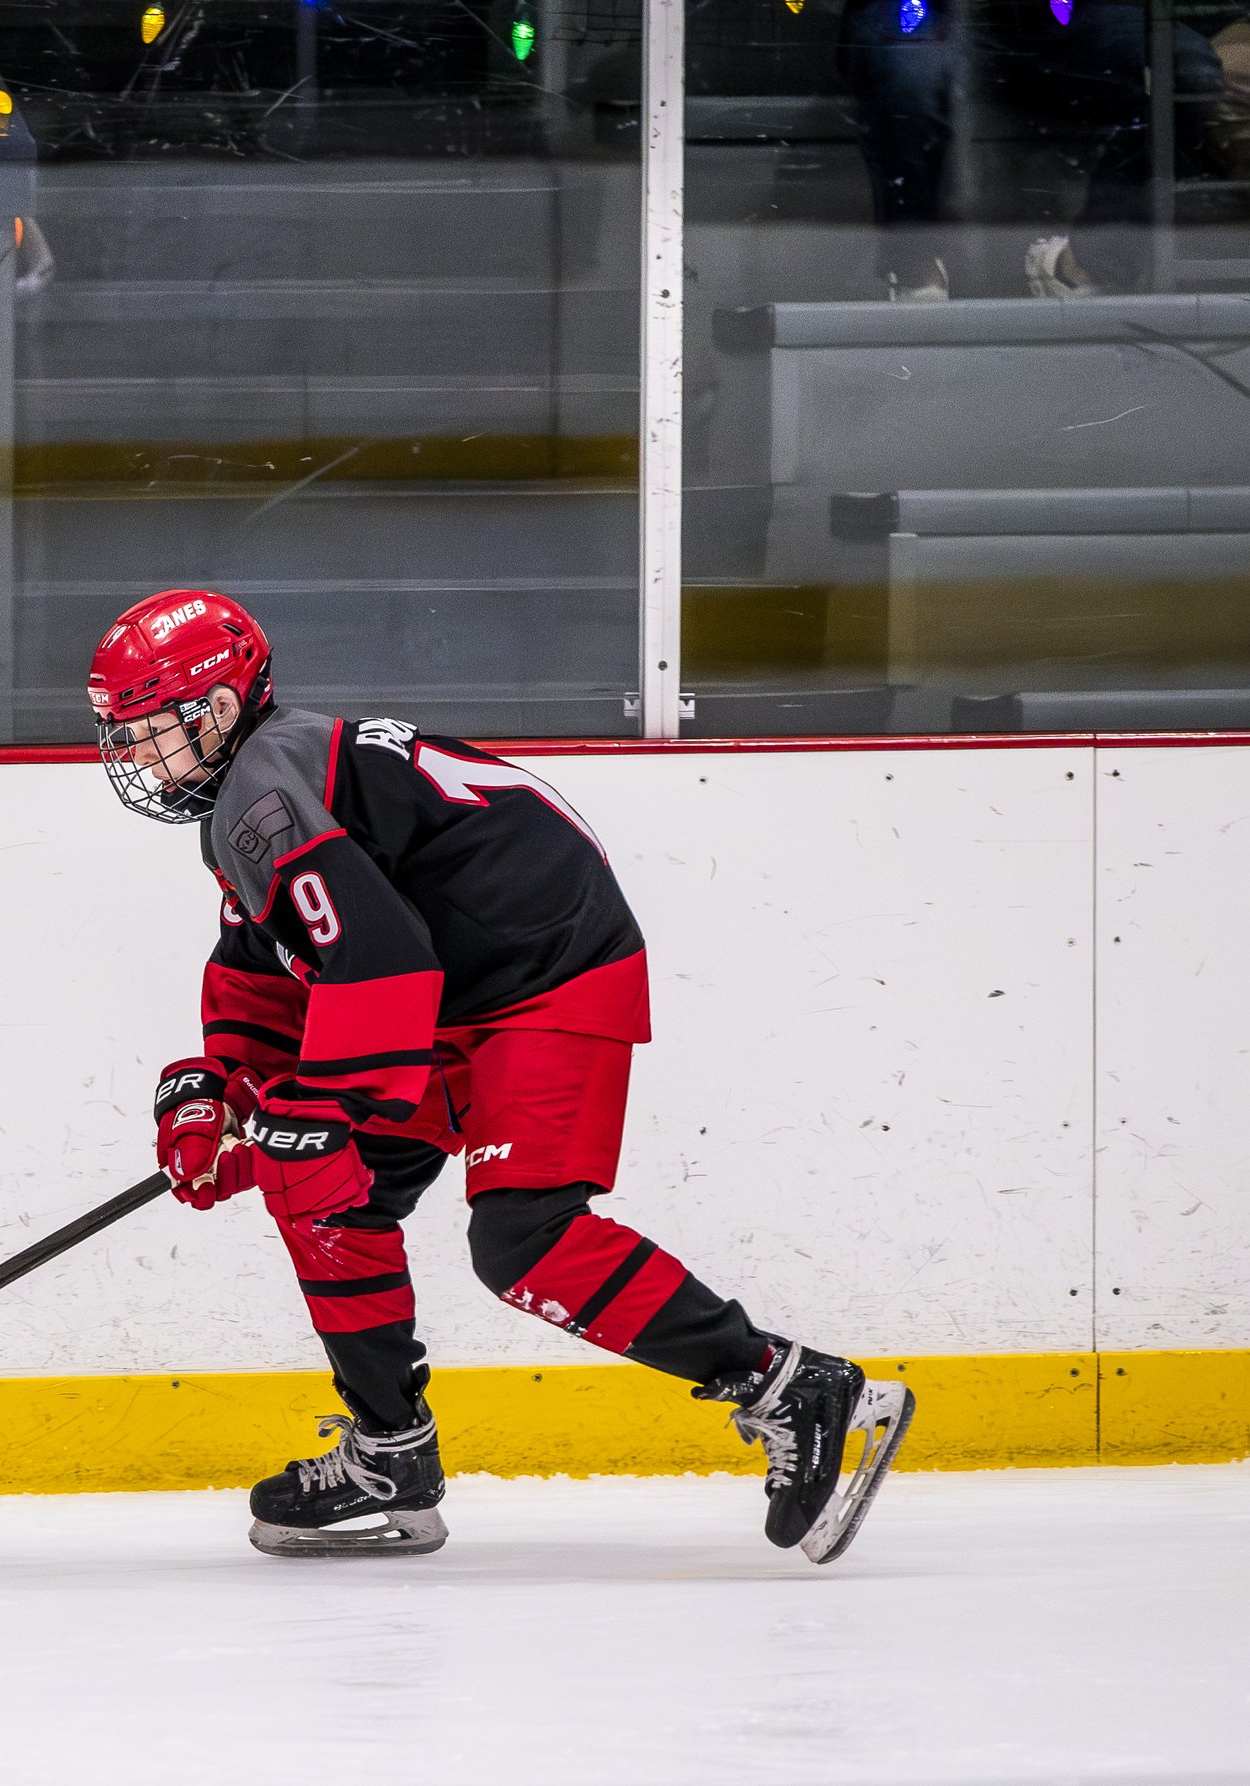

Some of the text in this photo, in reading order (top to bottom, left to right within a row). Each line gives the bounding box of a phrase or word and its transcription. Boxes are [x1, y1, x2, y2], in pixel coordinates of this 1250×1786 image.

[190, 649, 229, 675] CCM
[184, 706, 211, 722] CCM
[290, 871, 342, 947] 9
